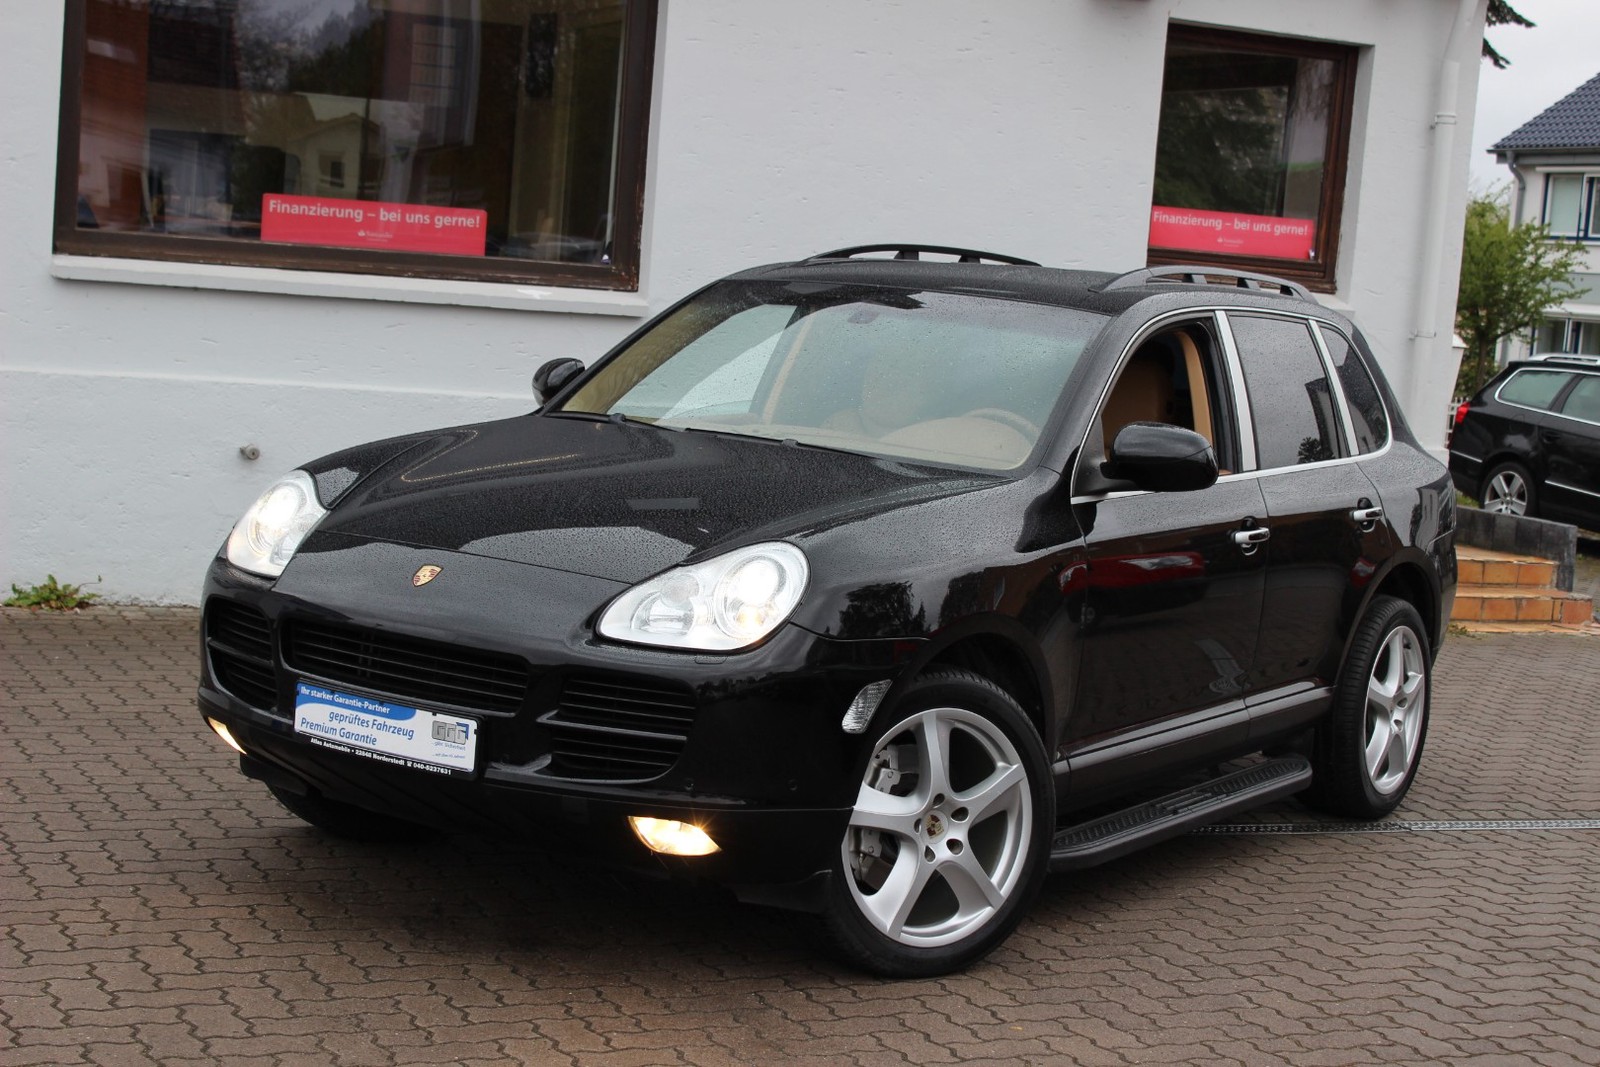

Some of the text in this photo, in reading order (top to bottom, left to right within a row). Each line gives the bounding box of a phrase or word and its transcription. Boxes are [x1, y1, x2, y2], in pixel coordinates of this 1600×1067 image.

[269, 200, 363, 222] Finanzierung
[380, 208, 401, 222] bei
[406, 213, 430, 225] uns
[434, 214, 480, 229] gerne!
[1153, 211, 1222, 231] Finanzierung
[1234, 218, 1250, 230] bei
[1253, 222, 1271, 232] uns
[1274, 224, 1308, 236] gerne!
[301, 686, 390, 714] Ihr starker Garantie-Partner
[301, 717, 377, 746] Premium Garantie
[329, 711, 414, 740] geprüftes Fahrzeug
[323, 741, 350, 753] Automobile
[373, 753, 405, 766] Norderstedt
